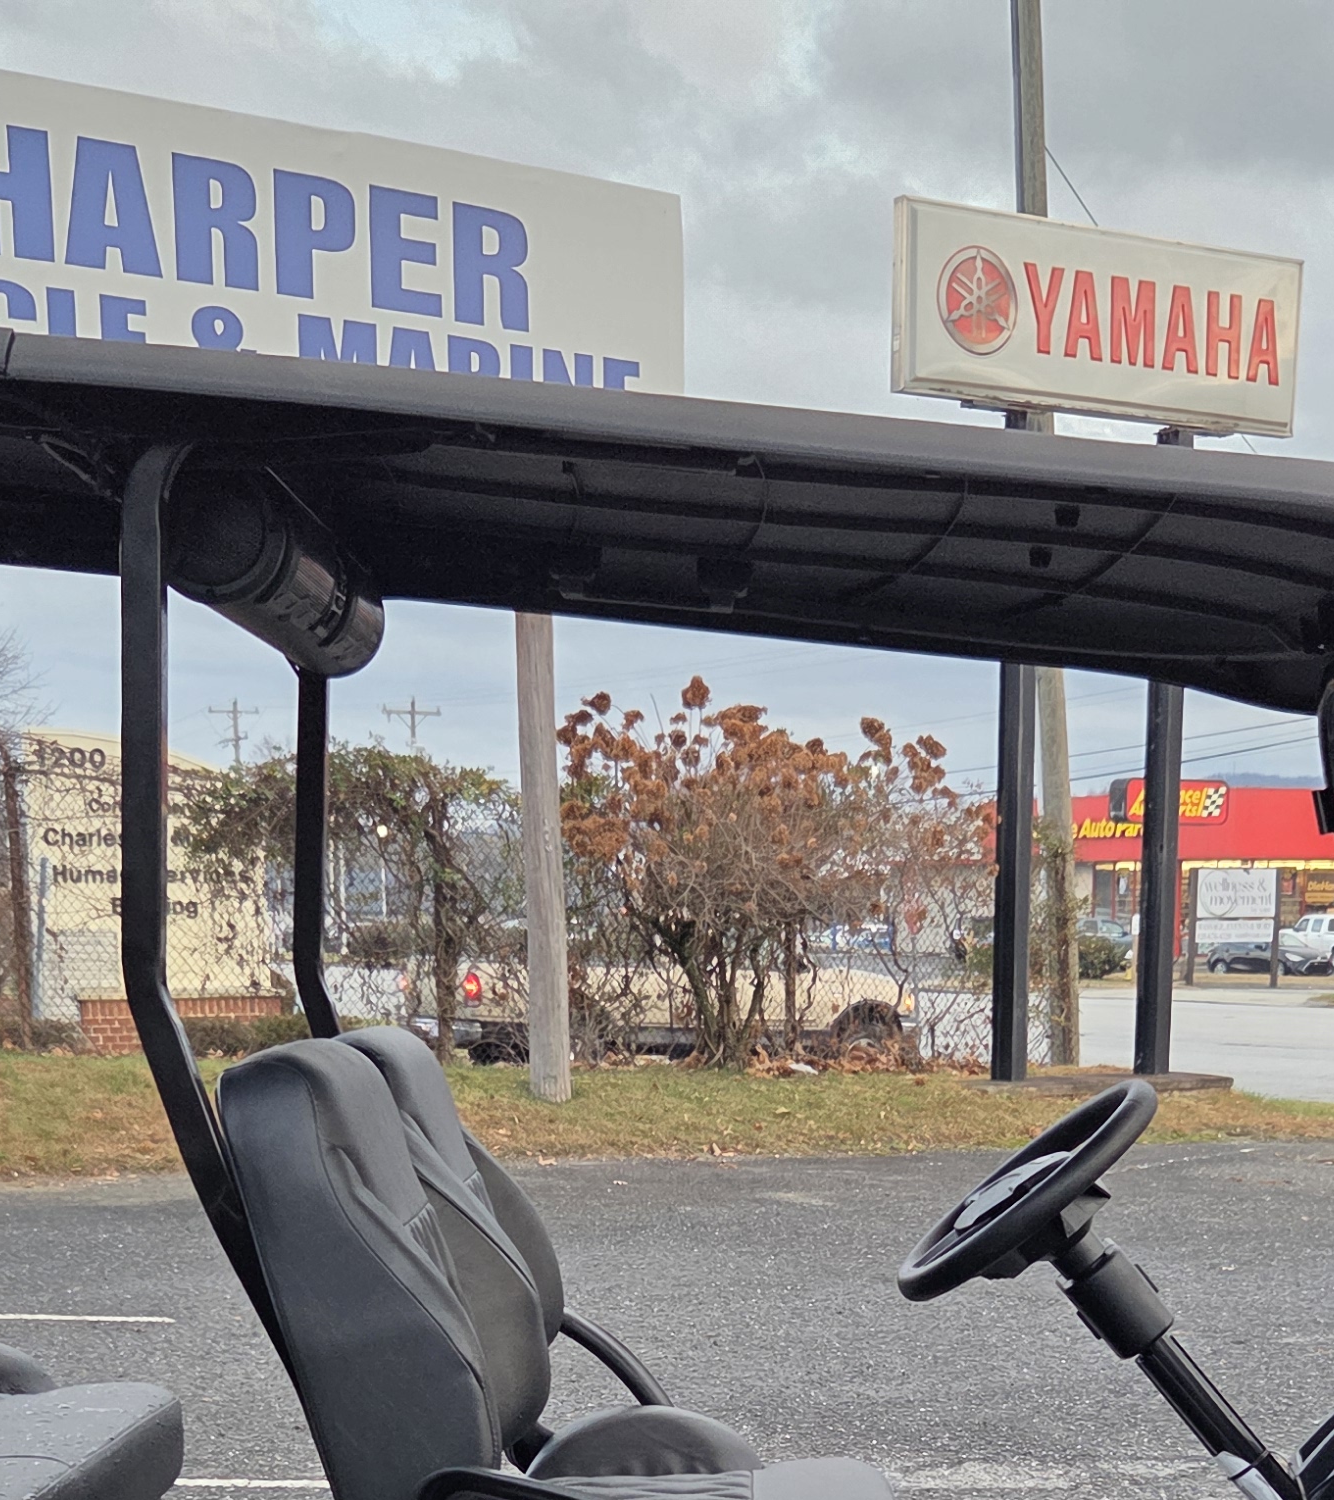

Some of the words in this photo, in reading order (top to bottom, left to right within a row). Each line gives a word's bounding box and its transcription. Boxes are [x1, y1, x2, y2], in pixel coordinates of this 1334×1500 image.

[1023, 261, 1280, 387] YAMAHA
[43, 828, 122, 848] Charle
[1078, 817, 1115, 839] Auto
[52, 864, 122, 885] Huma
